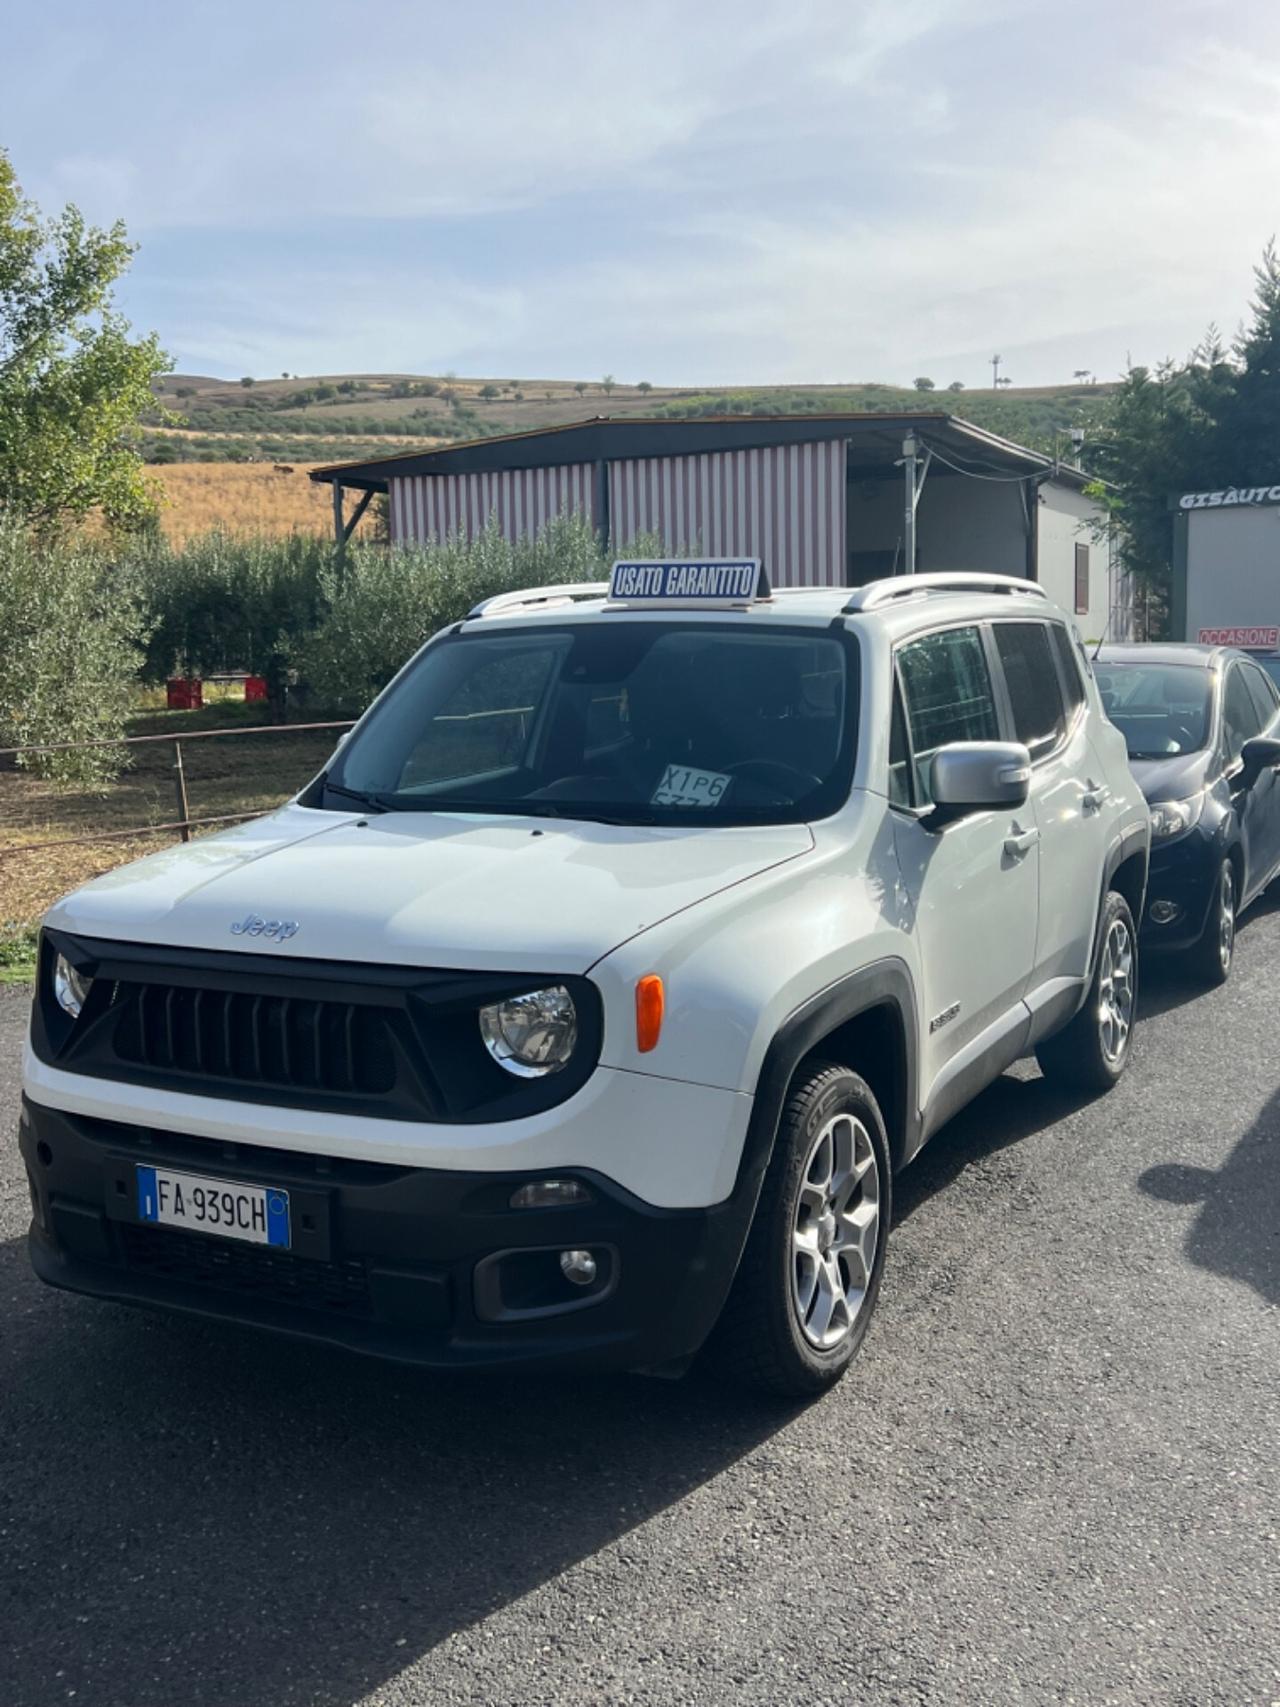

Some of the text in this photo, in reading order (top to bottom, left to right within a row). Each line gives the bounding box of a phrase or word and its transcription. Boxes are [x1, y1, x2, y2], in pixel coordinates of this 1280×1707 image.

[615, 565, 752, 596] USATO GARANTITO
[1200, 629, 1277, 645] OCCASIONE
[229, 912, 300, 944] Jeep
